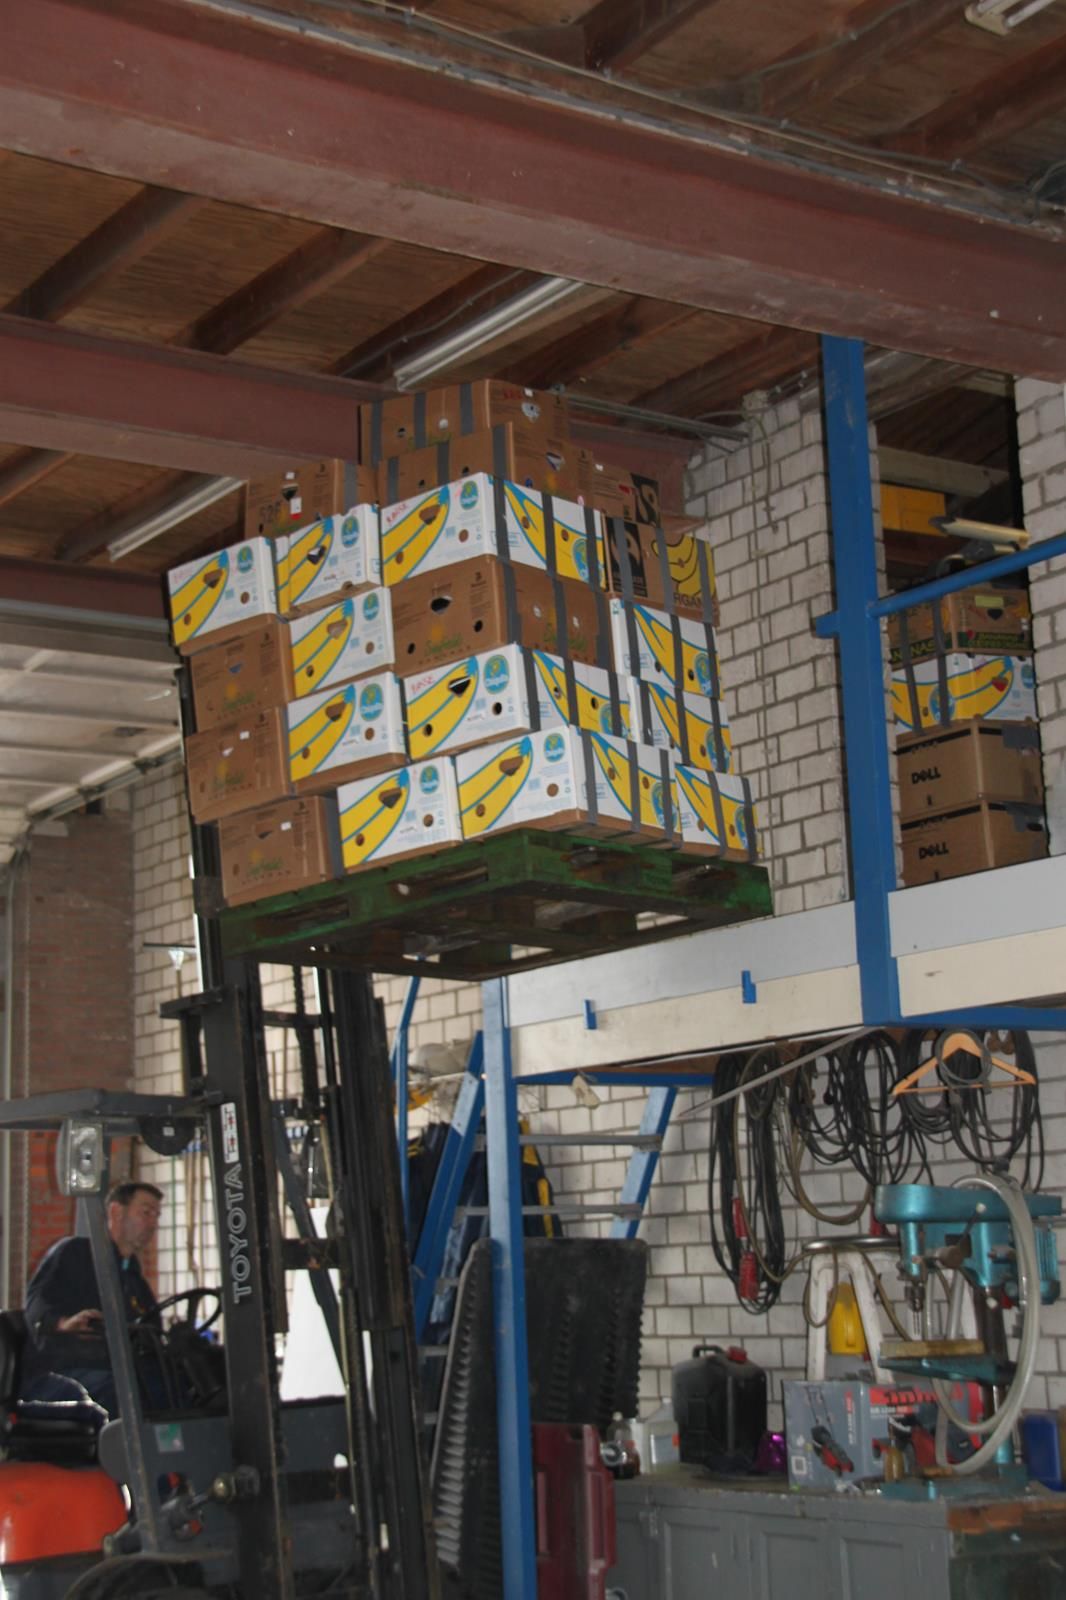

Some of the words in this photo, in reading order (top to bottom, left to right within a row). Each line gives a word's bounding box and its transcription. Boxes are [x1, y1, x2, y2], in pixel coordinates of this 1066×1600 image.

[911, 767, 941, 785] DELL
[918, 842, 949, 860] DELL
[224, 1163, 252, 1305] TOYOTA
